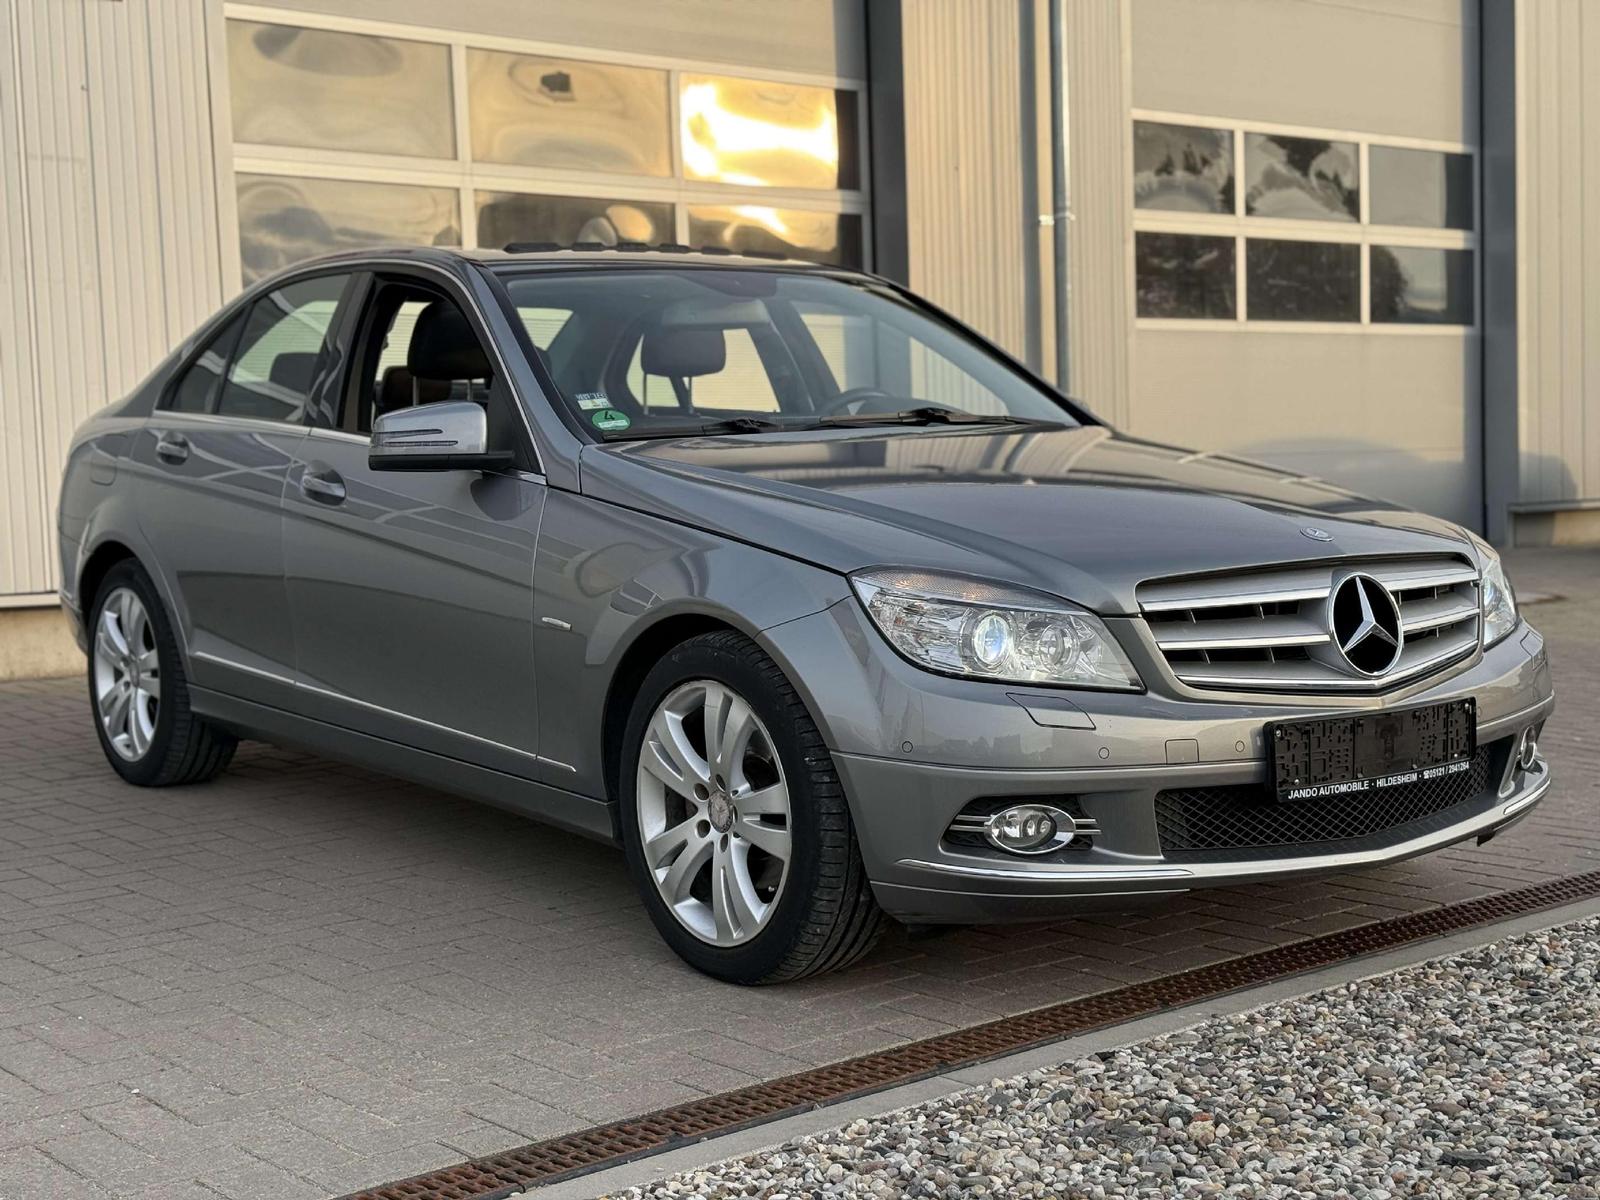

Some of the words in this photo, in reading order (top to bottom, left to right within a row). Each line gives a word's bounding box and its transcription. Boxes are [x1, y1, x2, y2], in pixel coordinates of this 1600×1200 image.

[604, 410, 615, 420] 4
[1288, 788, 1317, 799] JANDO
[1319, 780, 1369, 796] AUTOMOBILE
[1376, 772, 1418, 788] HILDESHEIM
